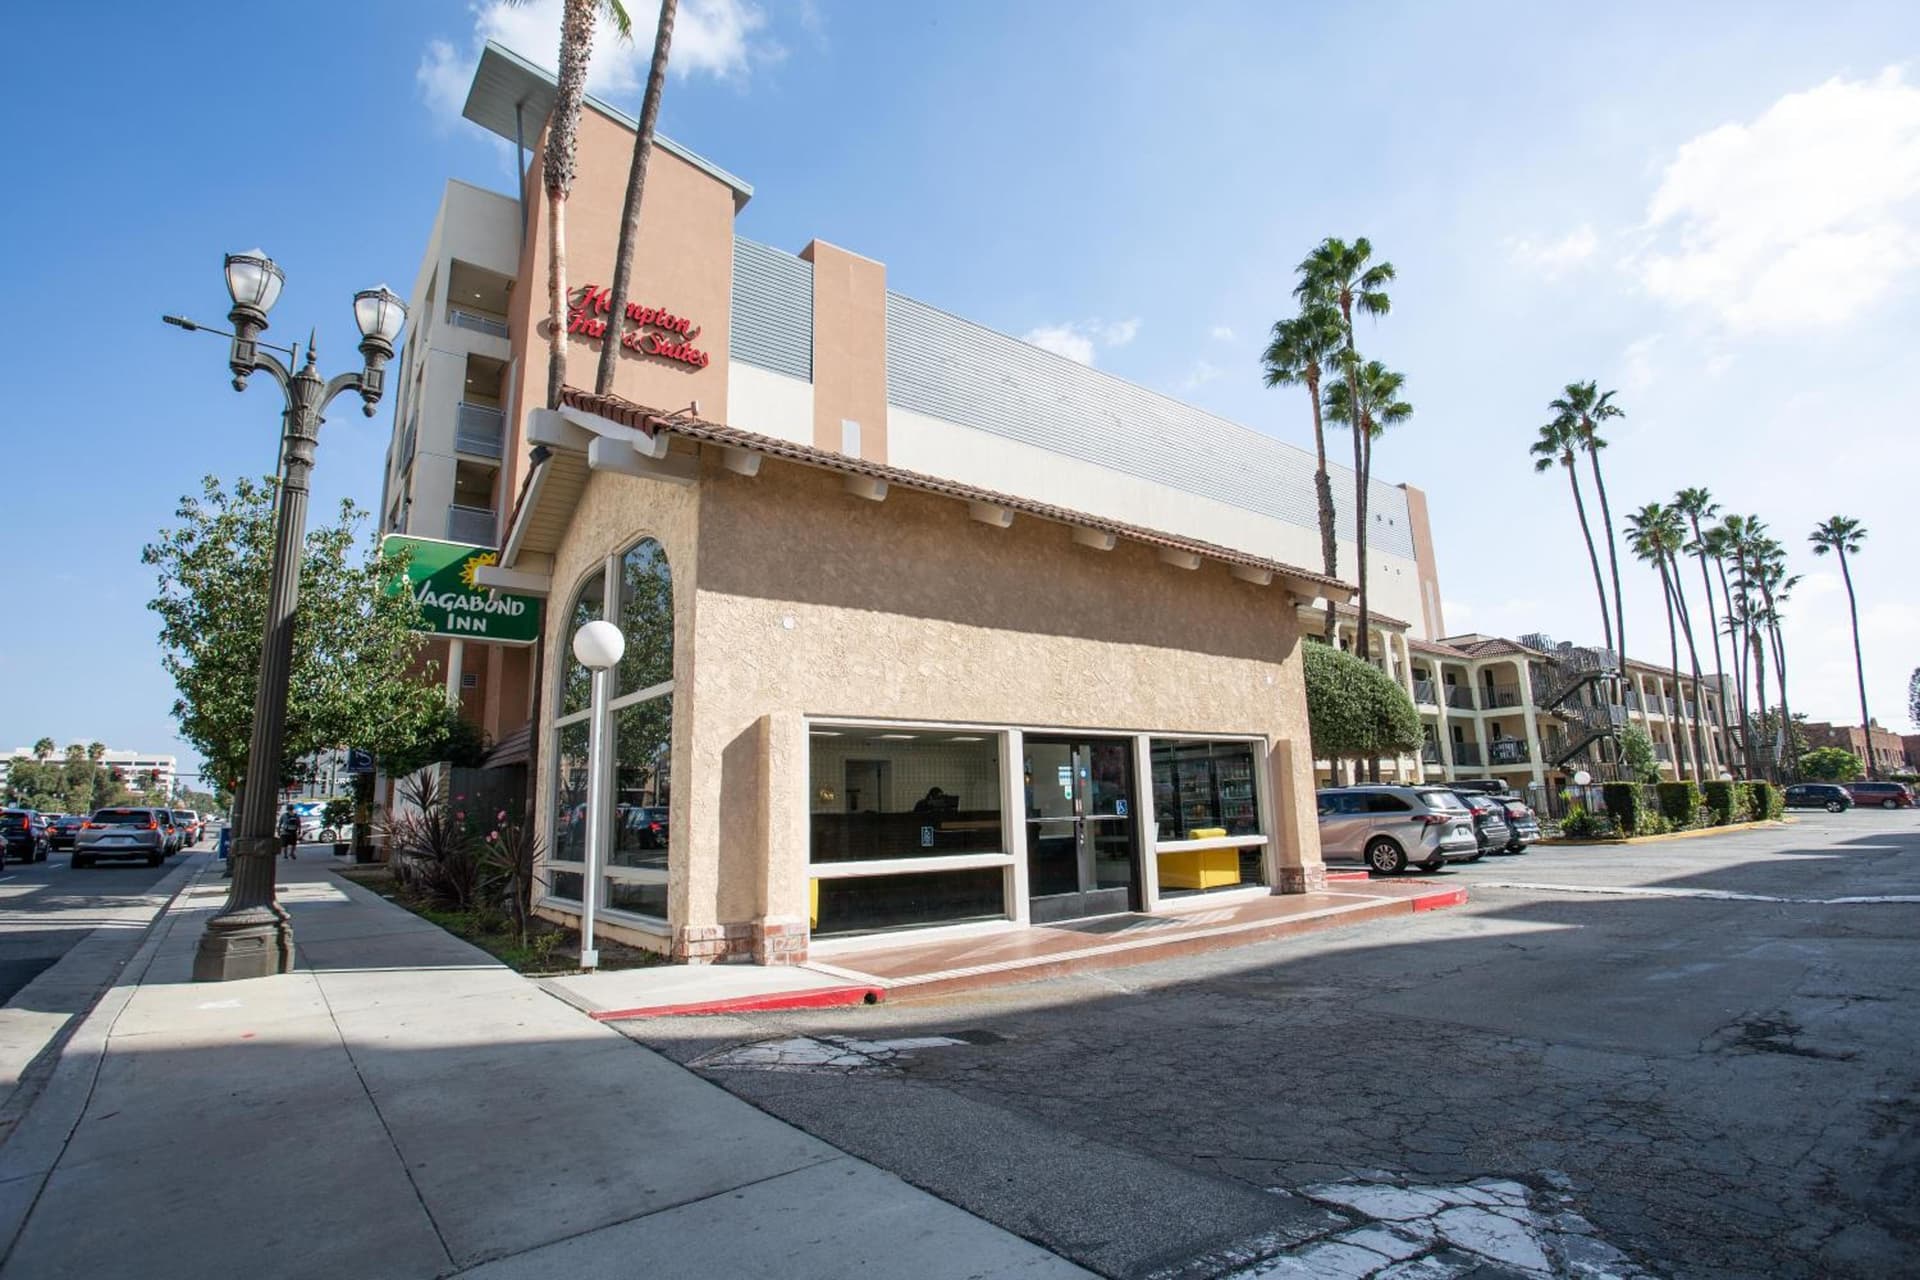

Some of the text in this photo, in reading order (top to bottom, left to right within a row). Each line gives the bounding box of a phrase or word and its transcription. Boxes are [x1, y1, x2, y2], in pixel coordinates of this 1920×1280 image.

[640, 330, 709, 368] Suites
[410, 579, 525, 616] VAGABOND
[447, 613, 487, 632] INN
